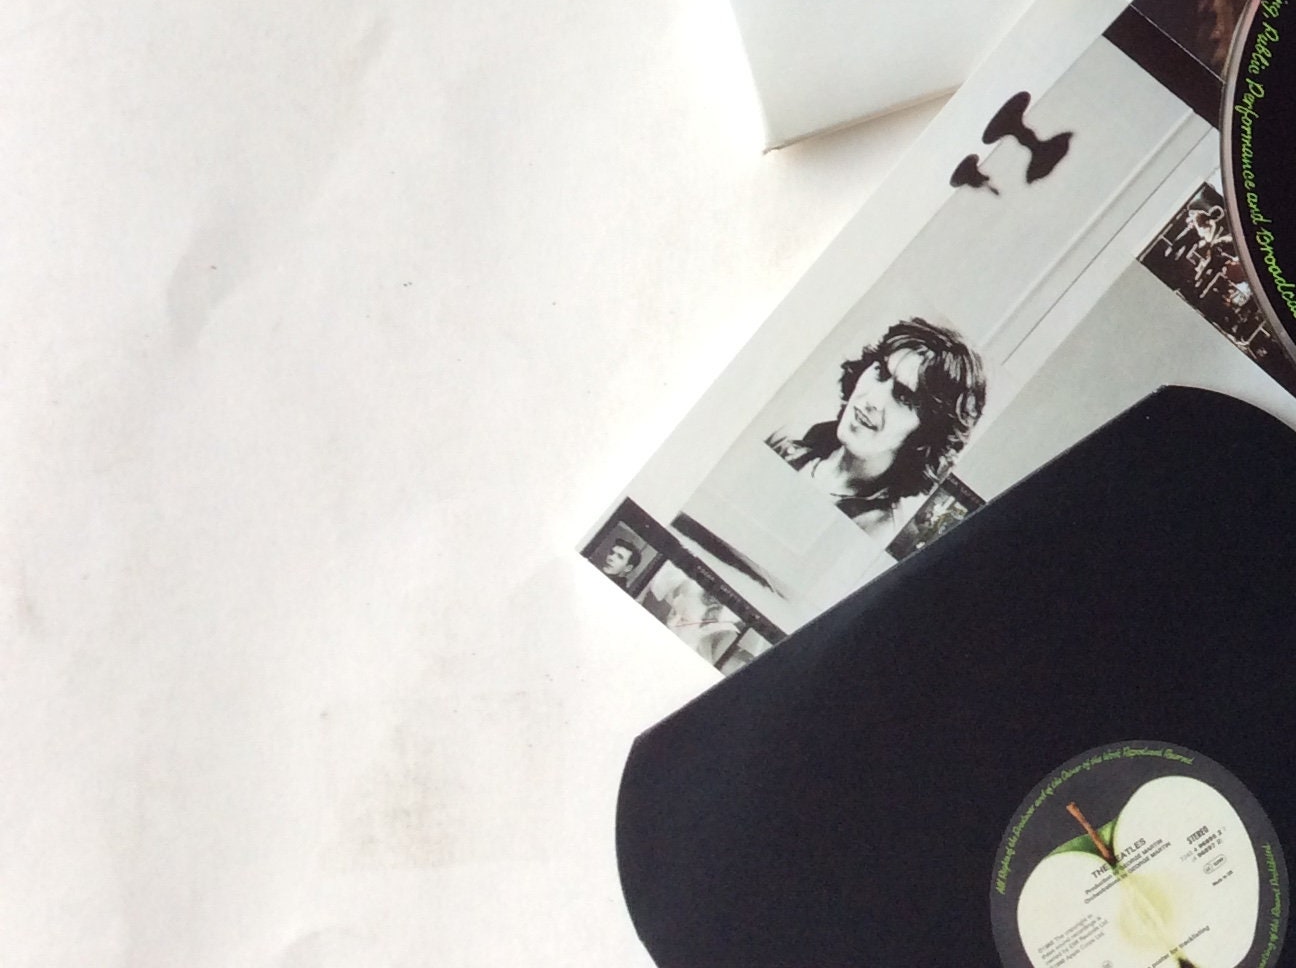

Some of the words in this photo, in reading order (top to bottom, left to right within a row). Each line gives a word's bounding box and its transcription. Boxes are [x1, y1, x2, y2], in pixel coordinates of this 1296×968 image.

[1248, 21, 1280, 75] Public
[1234, 77, 1265, 195] Performance
[1246, 193, 1272, 225] and
[1090, 862, 1110, 879] THE
